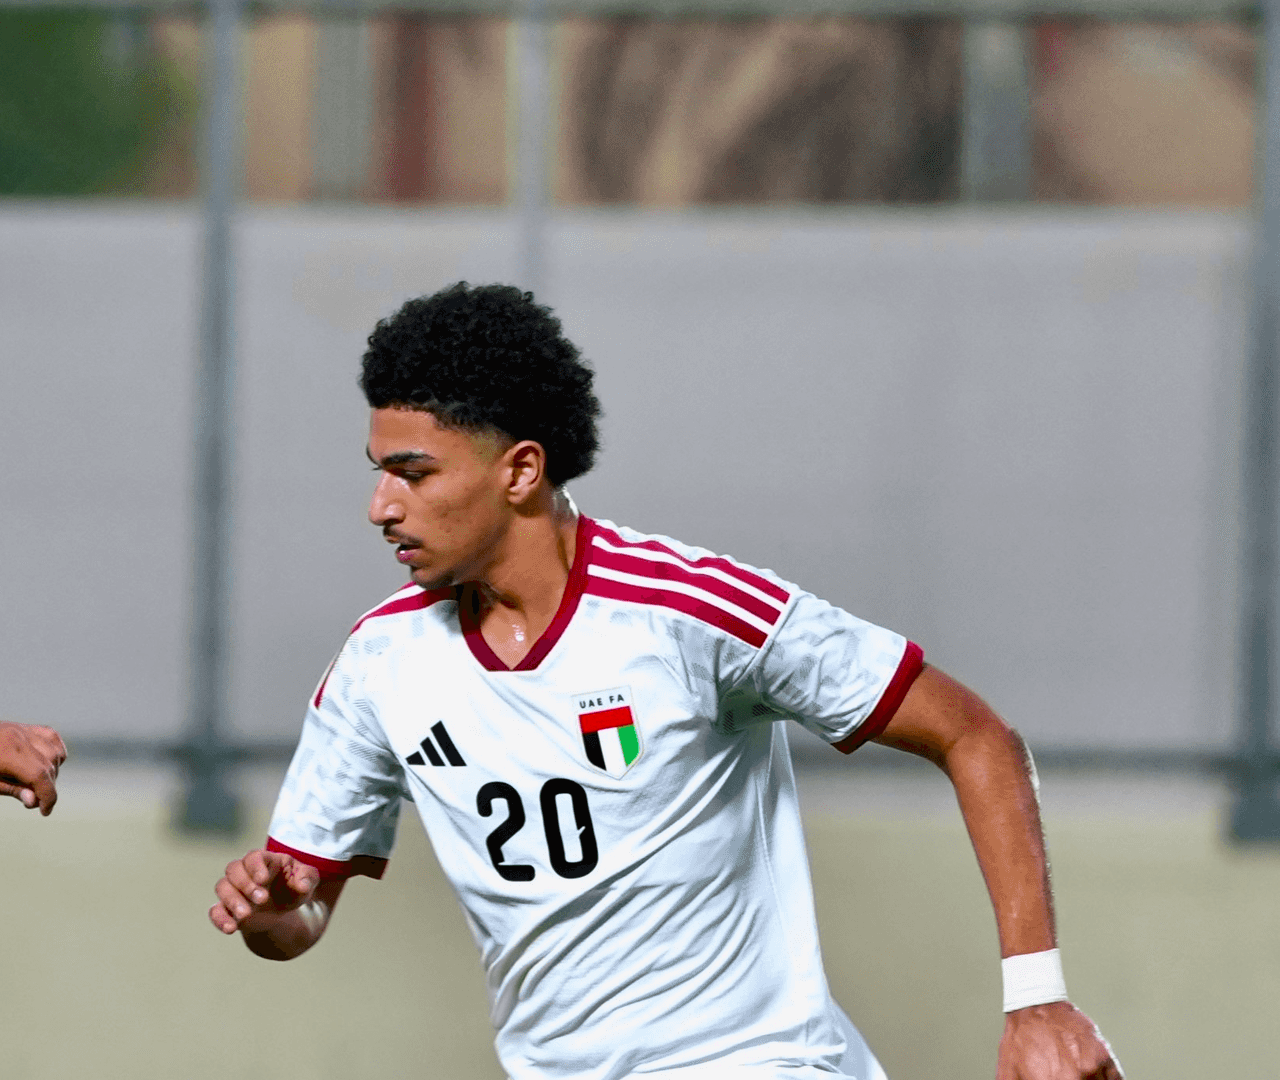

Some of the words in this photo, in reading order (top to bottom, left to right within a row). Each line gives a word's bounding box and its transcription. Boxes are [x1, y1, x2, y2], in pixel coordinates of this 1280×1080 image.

[579, 697, 603, 709] UAE
[609, 694, 625, 704] FA
[476, 778, 599, 881] 20
